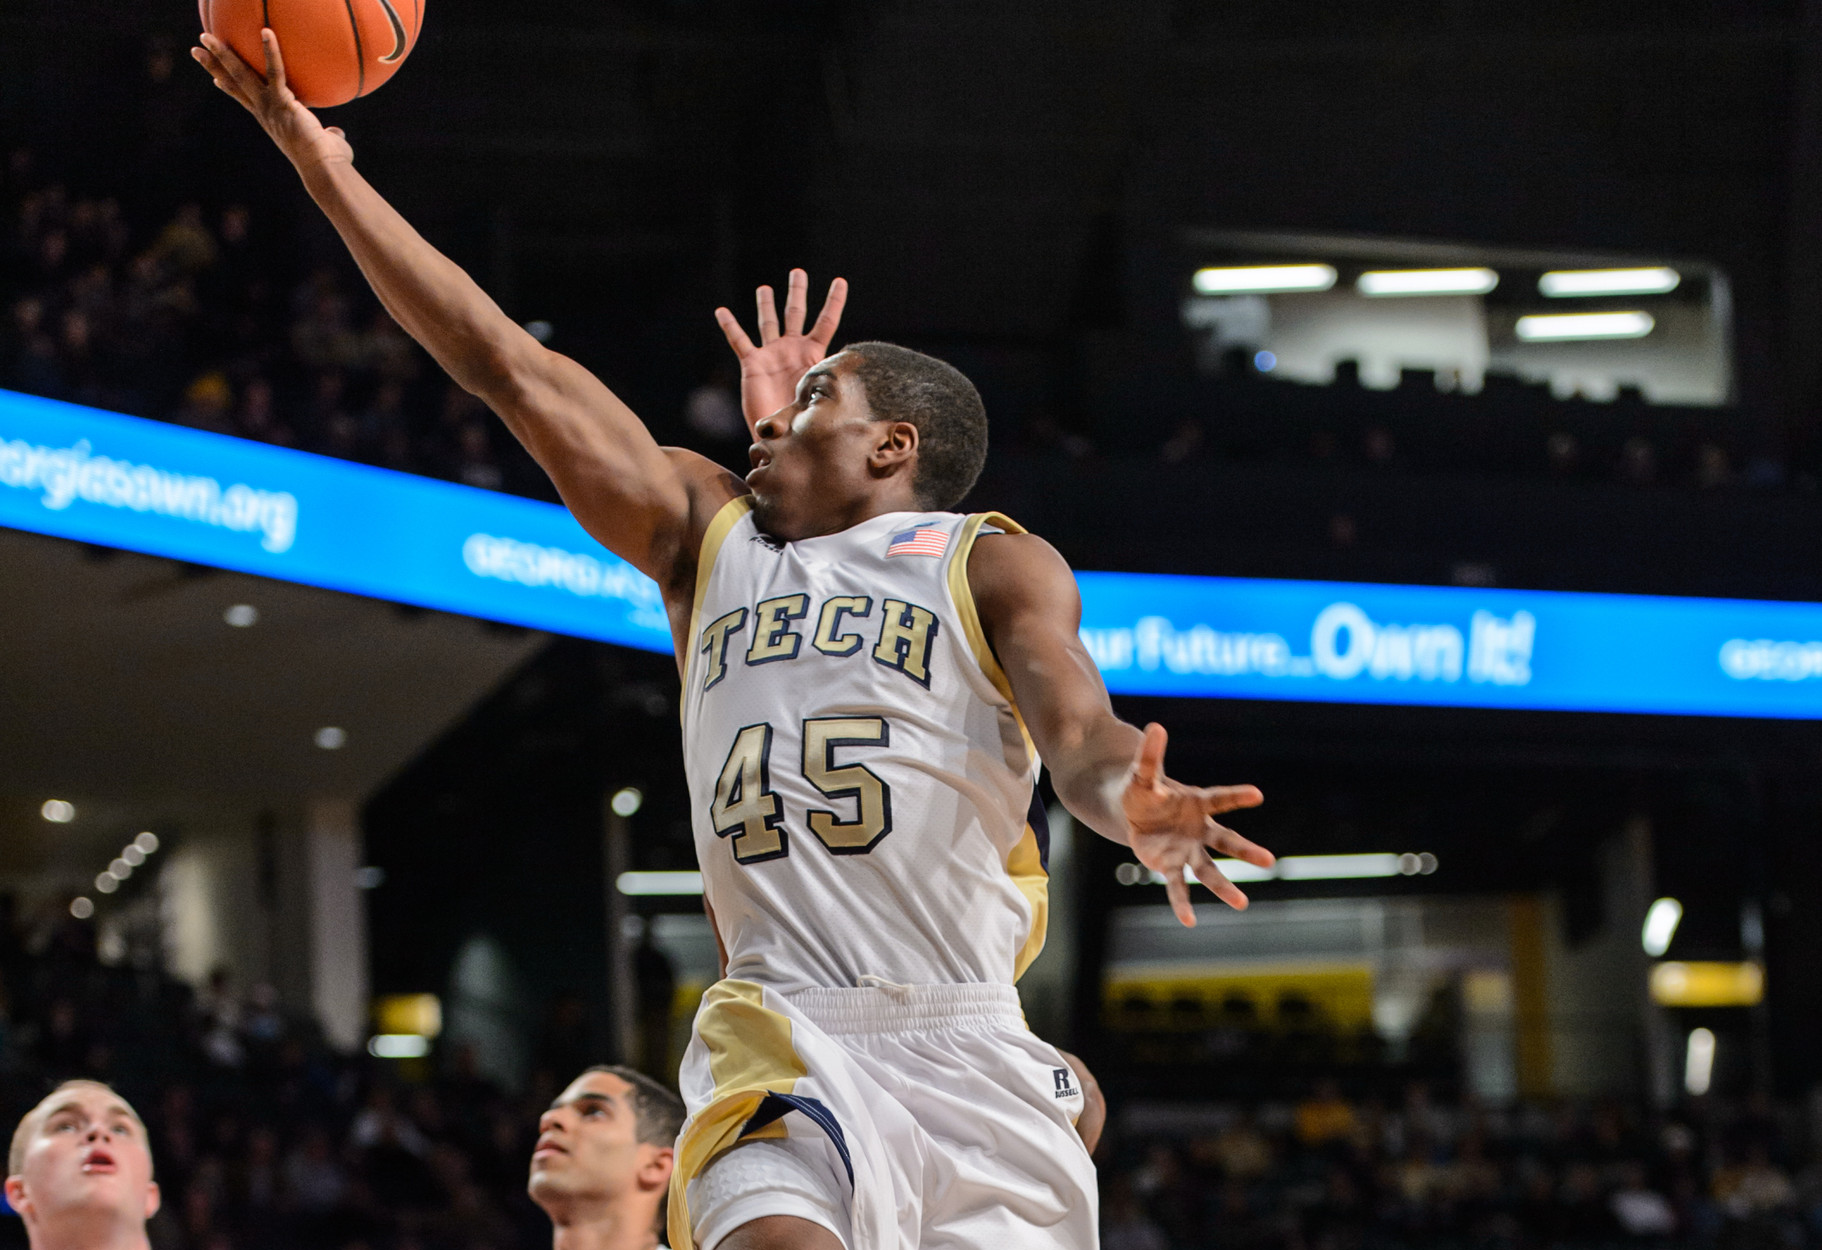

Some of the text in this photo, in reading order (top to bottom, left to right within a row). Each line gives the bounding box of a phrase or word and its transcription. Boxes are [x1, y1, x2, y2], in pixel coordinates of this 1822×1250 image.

[701, 592, 939, 692] TECH
[1311, 602, 1465, 682] Own
[710, 716, 893, 865] 45
[1053, 1068, 1070, 1090] R
